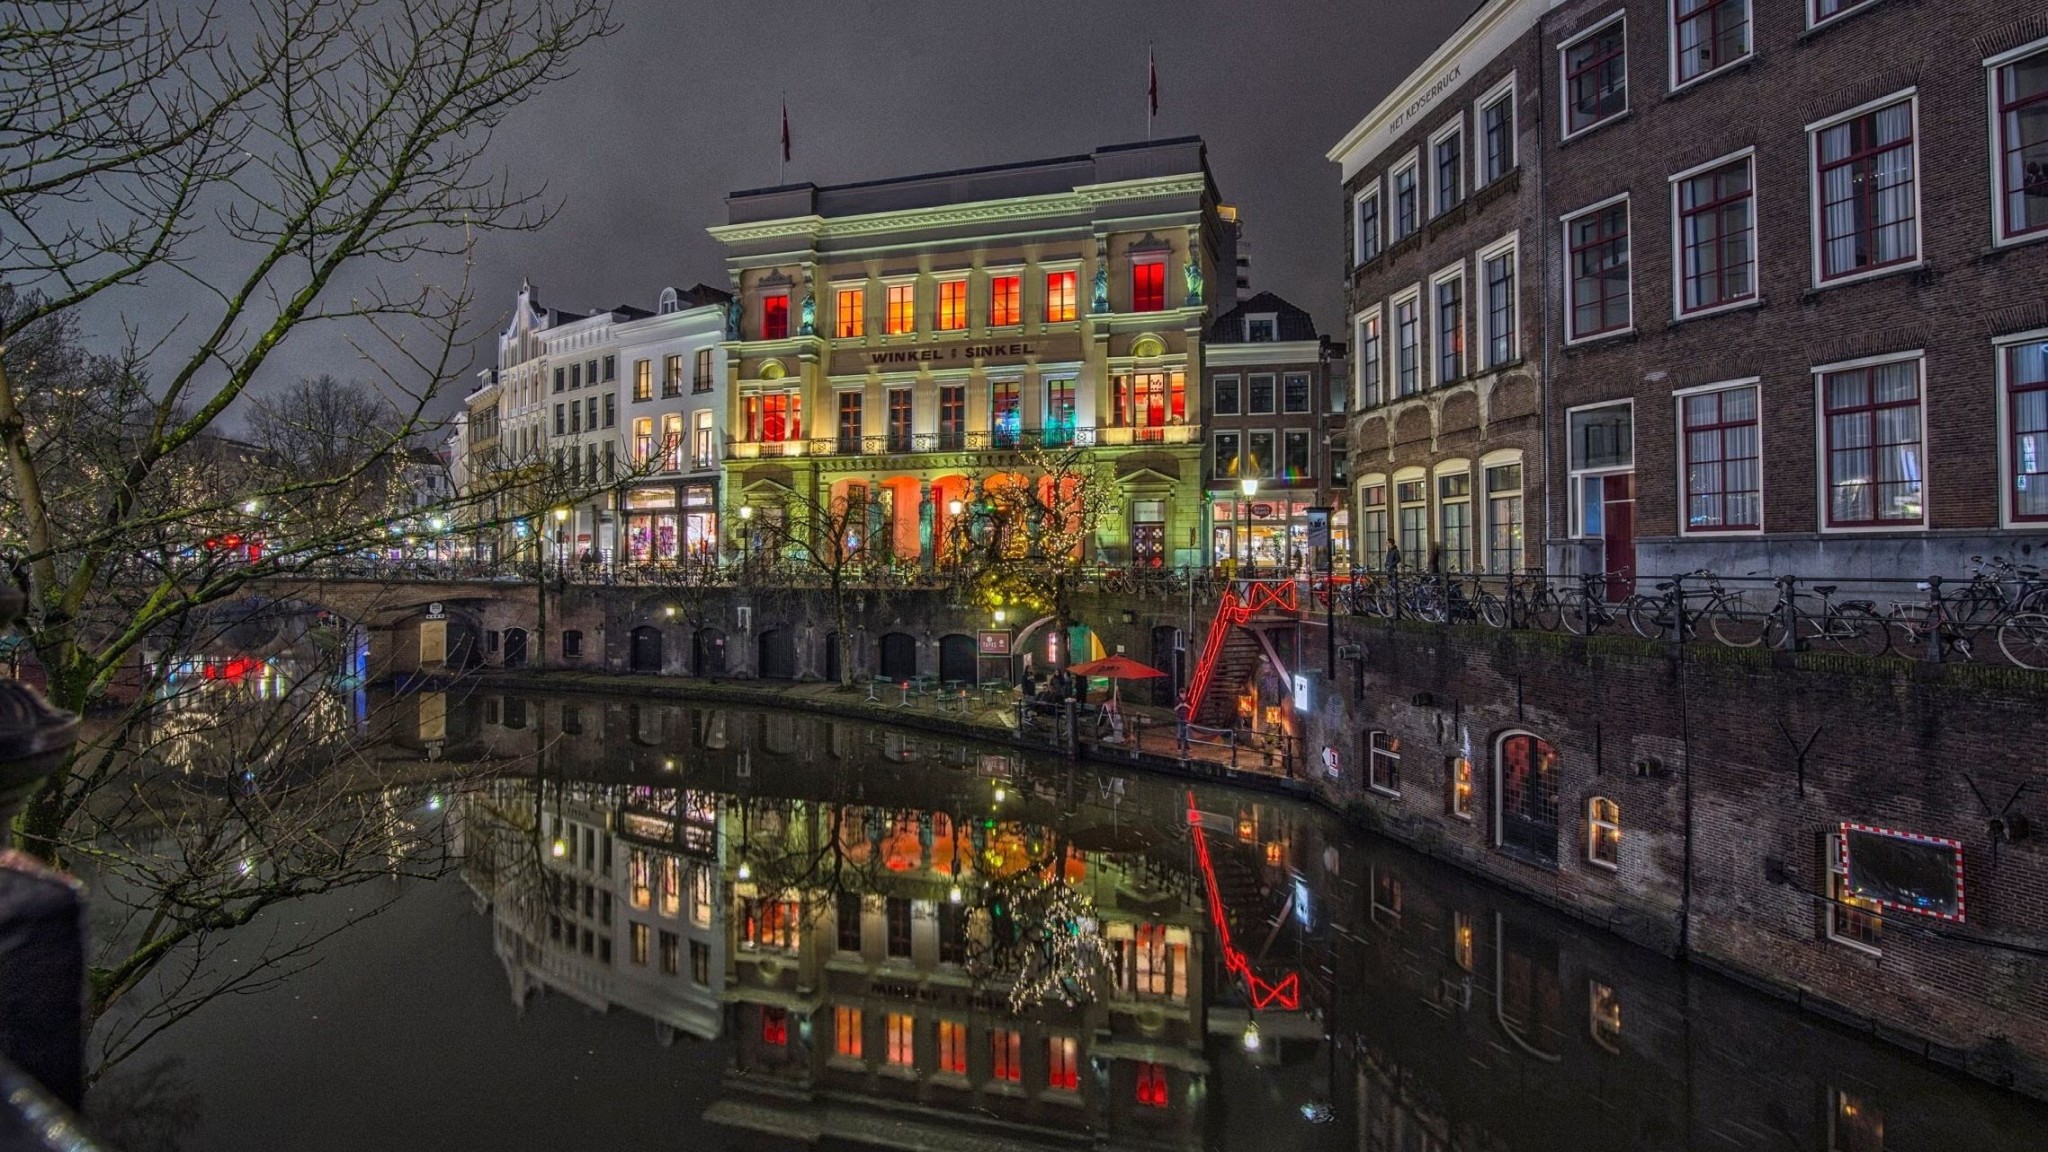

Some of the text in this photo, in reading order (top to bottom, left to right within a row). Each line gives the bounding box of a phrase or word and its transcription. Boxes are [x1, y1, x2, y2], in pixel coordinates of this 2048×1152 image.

[1390, 65, 1461, 133] HET KEYSERRUCK
[872, 350, 943, 364] WINKEL
[965, 343, 1035, 358] SINKEL
